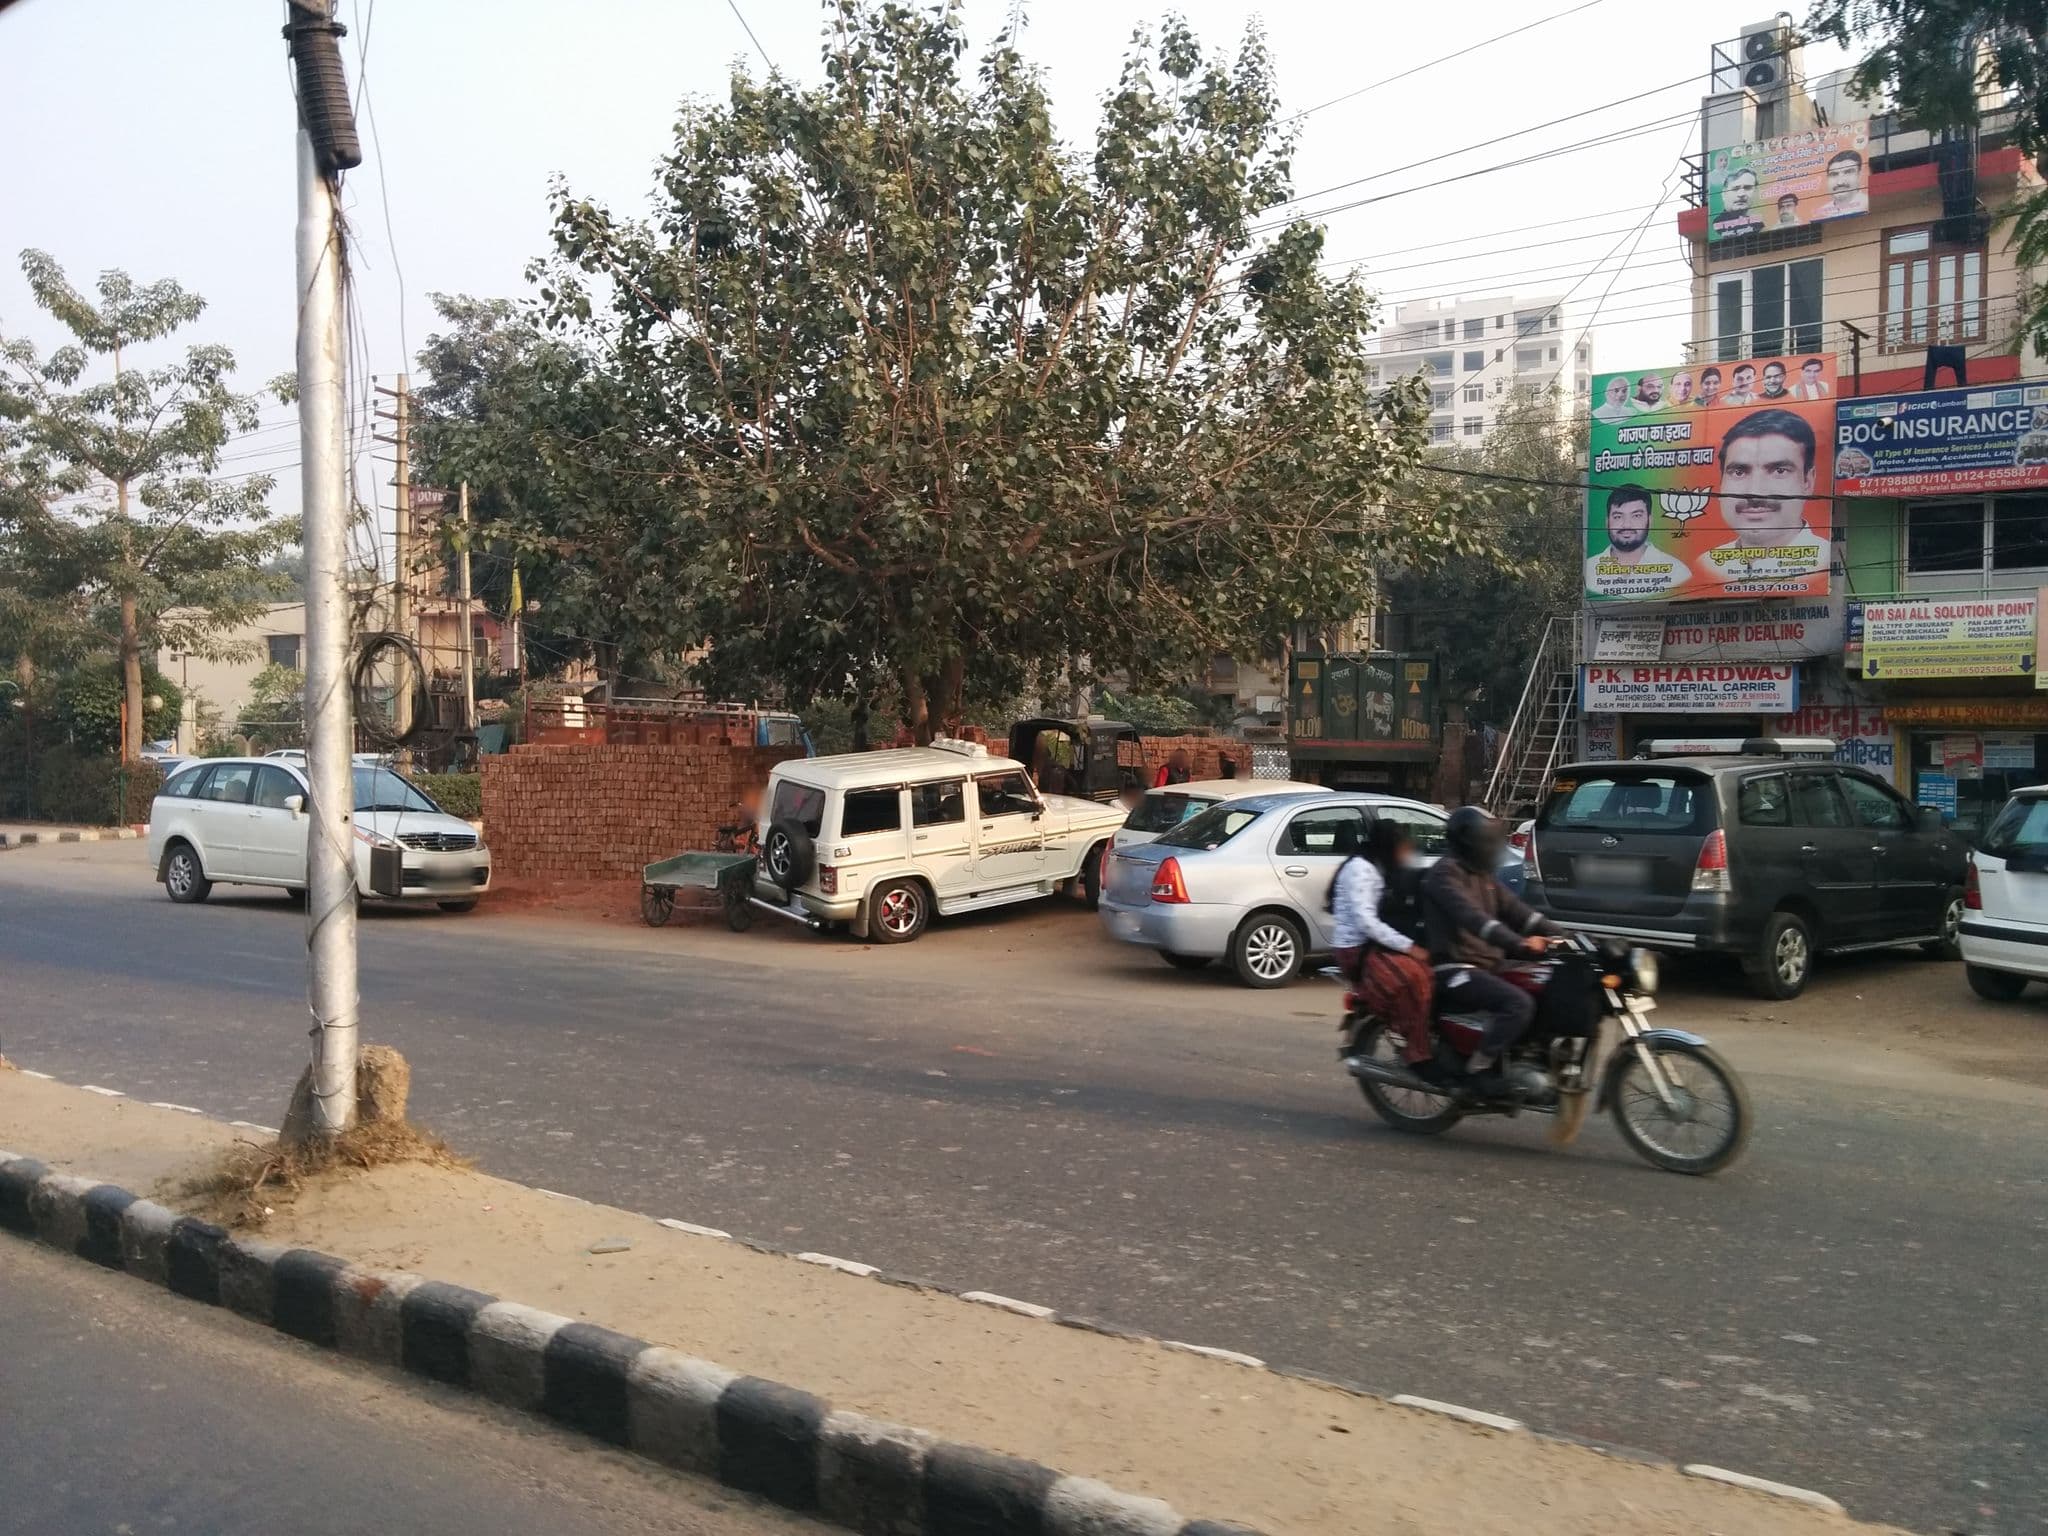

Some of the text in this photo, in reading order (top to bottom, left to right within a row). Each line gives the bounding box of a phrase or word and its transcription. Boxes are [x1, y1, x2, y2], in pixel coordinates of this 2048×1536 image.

[1618, 422, 1692, 444] भाजपा का इरादा
[1839, 423, 1886, 445] BOC
[1893, 409, 2030, 440] INSURANCE
[1595, 446, 1714, 473] हरियाणा के विकास का वादा
[1885, 449, 1902, 459] Type
[1914, 446, 1949, 455] Insurance
[1951, 444, 1982, 453] Services
[1714, 611, 1739, 625] LAND
[1789, 605, 1830, 621] HARYANA
[1866, 602, 2034, 622] OM SAI ALL SOLUTION POINT
[1708, 624, 1740, 643] FAIR
[1744, 623, 1805, 643] DEALING
[1589, 665, 1792, 683] P.K. BHARDWAJ
[1598, 682, 1776, 693] BUILDING MATERIAL CARRIER
[1694, 692, 1738, 701] STOCKISTS
